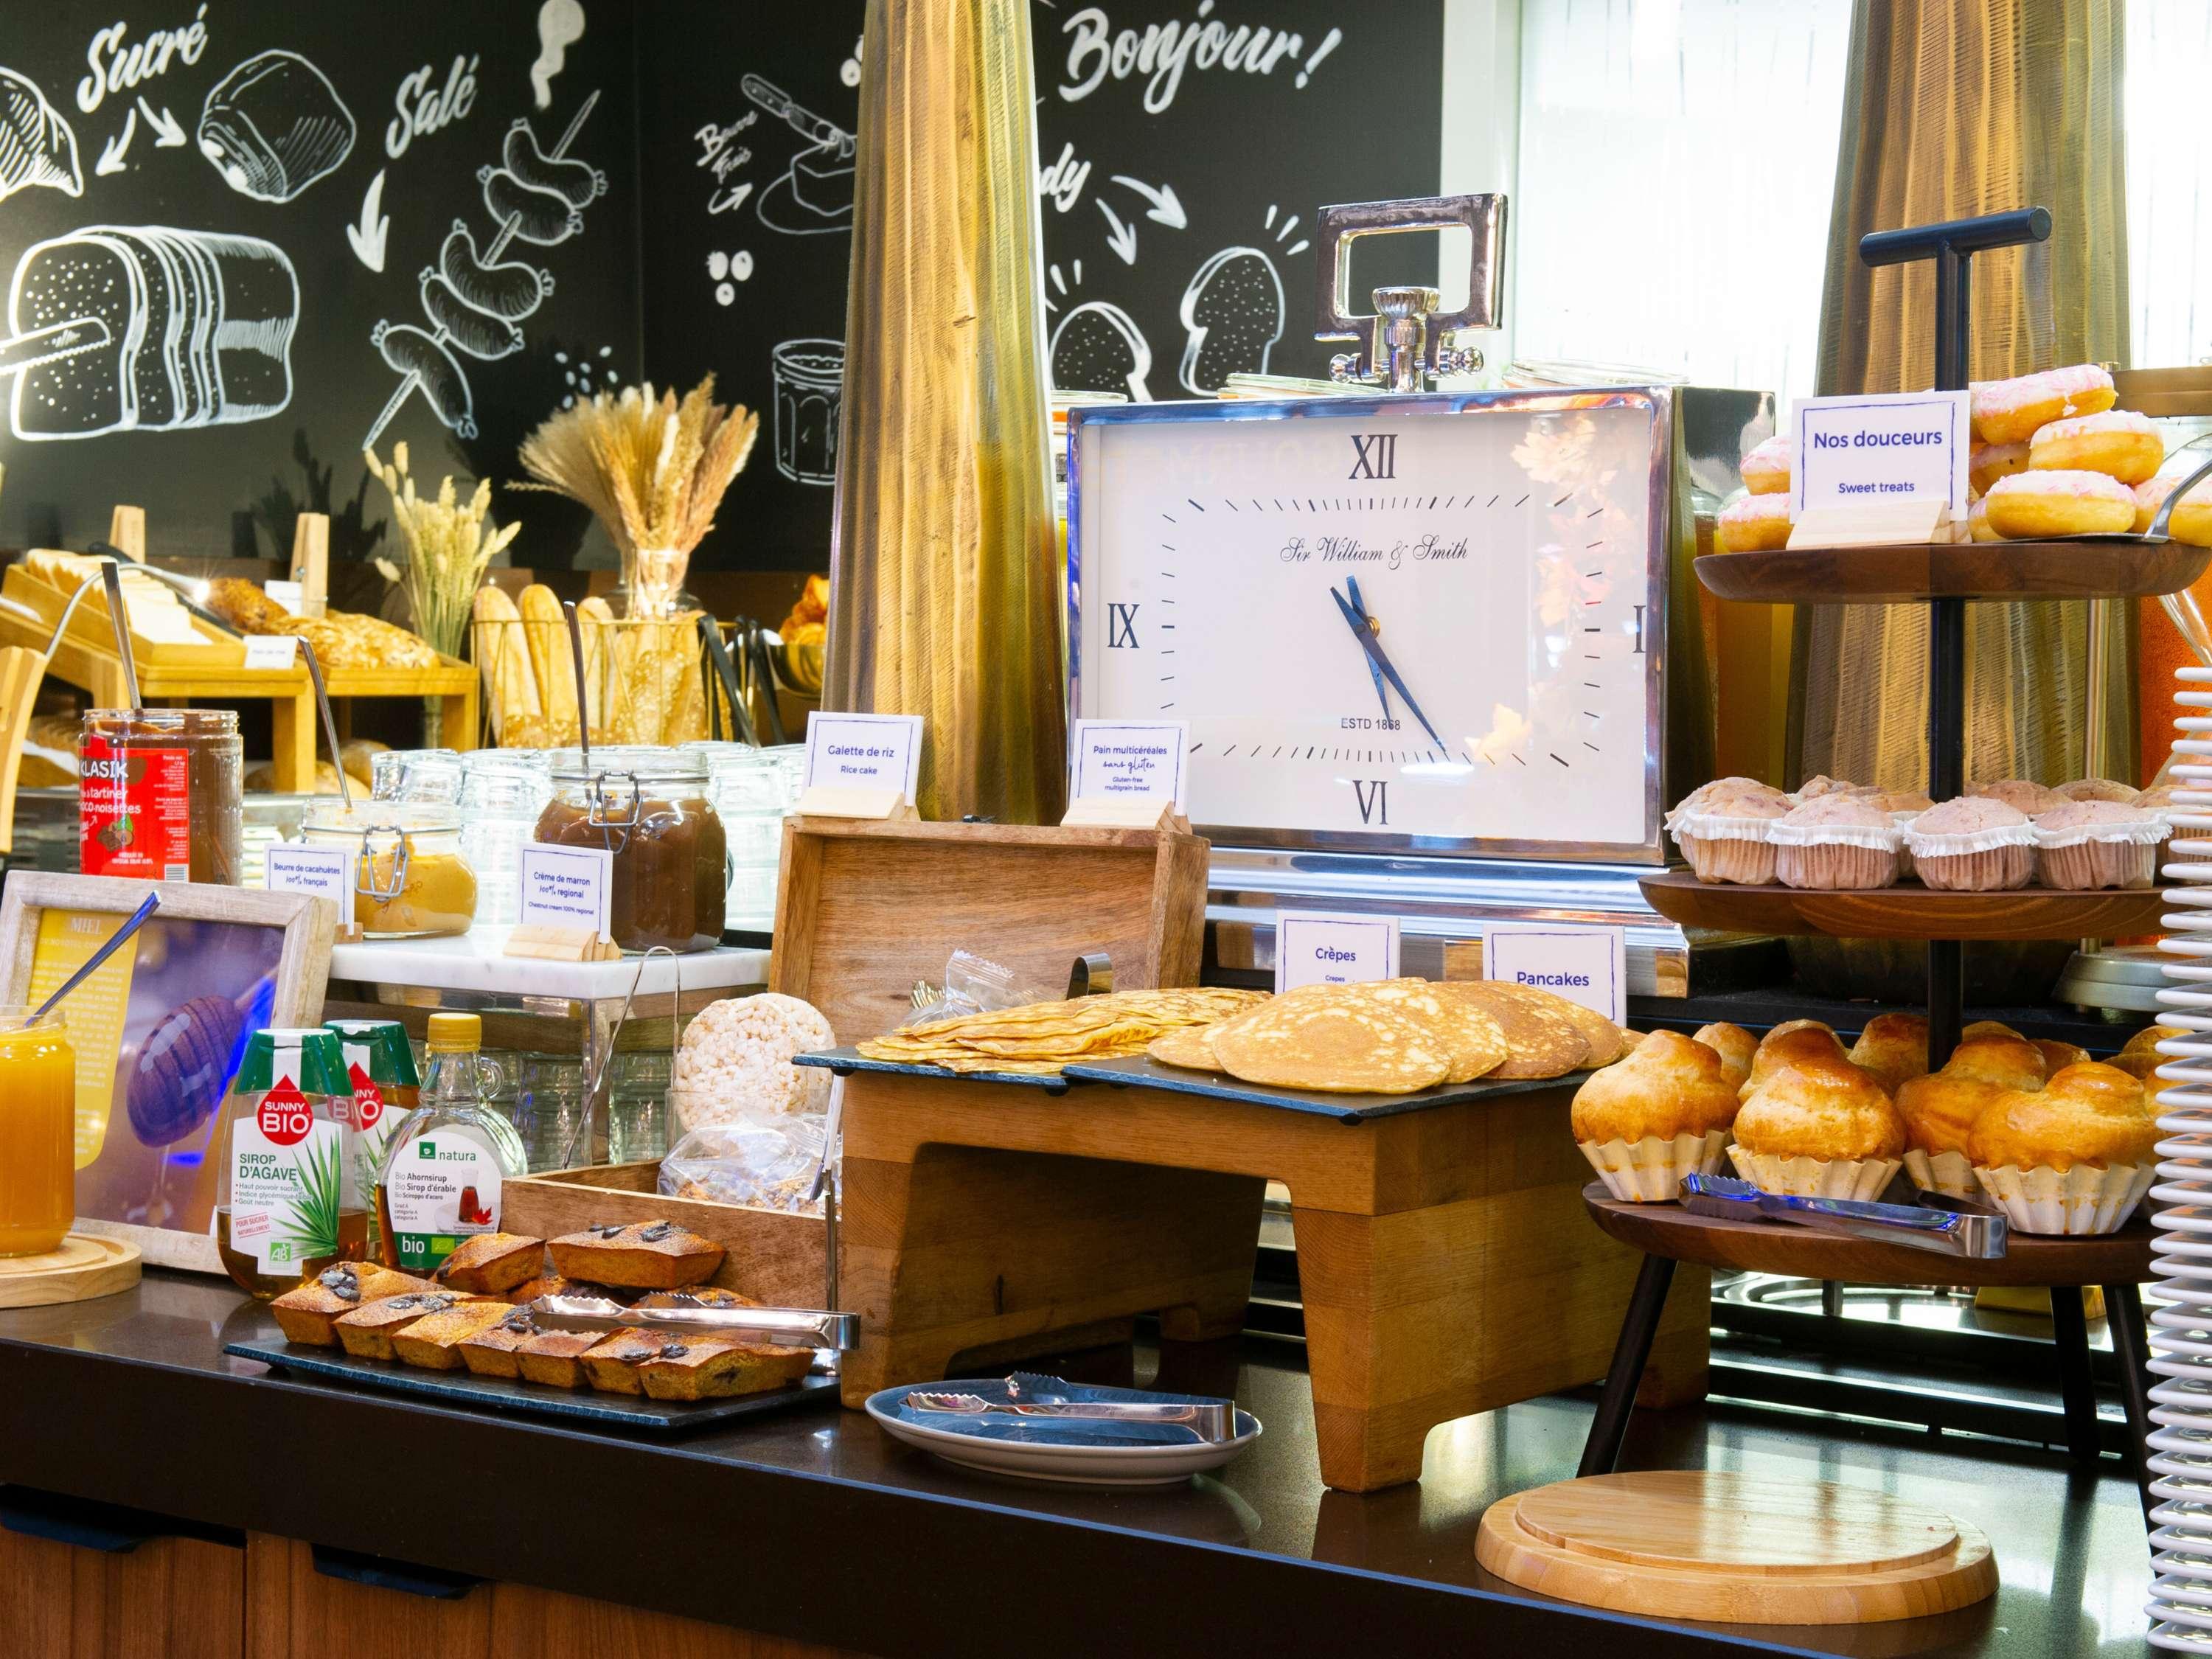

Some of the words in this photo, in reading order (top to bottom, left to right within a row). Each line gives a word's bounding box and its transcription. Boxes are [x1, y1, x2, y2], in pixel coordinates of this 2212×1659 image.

[77, 2, 209, 114] Sucré
[386, 52, 480, 159] Salé
[1814, 432, 1849, 449] Nos
[1854, 430, 1943, 448] douceurs
[1348, 434, 1399, 479] XII
[1838, 482, 1877, 494] Sweet
[1879, 481, 1915, 493] treats
[1280, 537, 1311, 562] Sir
[1316, 536, 1384, 562] William
[1388, 540, 1409, 570] &
[1412, 534, 1470, 560] Smith
[1107, 602, 1141, 649] IX
[1341, 717, 1371, 729] ESTD
[1375, 719, 1401, 731] 1868
[827, 745, 864, 757] Galette
[866, 746, 880, 757] de
[882, 747, 895, 758] riz
[1093, 745, 1111, 754] Pain
[1113, 745, 1168, 755] multicéréales
[840, 765, 858, 773] Rice
[859, 766, 877, 775] cake
[1127, 756, 1155, 774] gluten
[90, 786, 128, 799] tartiner
[1352, 779, 1388, 826] VI
[274, 863, 295, 872] Beurre
[296, 864, 304, 872] de
[303, 877, 328, 888] français
[534, 872, 555, 882] Crème
[556, 874, 565, 883] de
[566, 877, 591, 886] marron
[1517, 971, 1590, 987] Pancakes
[354, 1089, 375, 1098] NNY
[264, 1101, 305, 1112] SUNNY
[333, 1099, 380, 1120] BIO
[262, 1113, 310, 1134] BIO
[239, 1153, 276, 1165] SIROP
[439, 1150, 476, 1161] natura
[239, 1166, 297, 1181] D'AGAVE
[394, 1172, 406, 1180] Bio
[406, 1172, 448, 1183] Ahornsirup
[394, 1181, 406, 1191] Bio
[406, 1183, 425, 1194] Sirop
[427, 1183, 457, 1193] d'érable
[235, 1218, 249, 1228] POUR
[249, 1215, 270, 1225] SUCRER
[402, 1236, 425, 1254] bio
